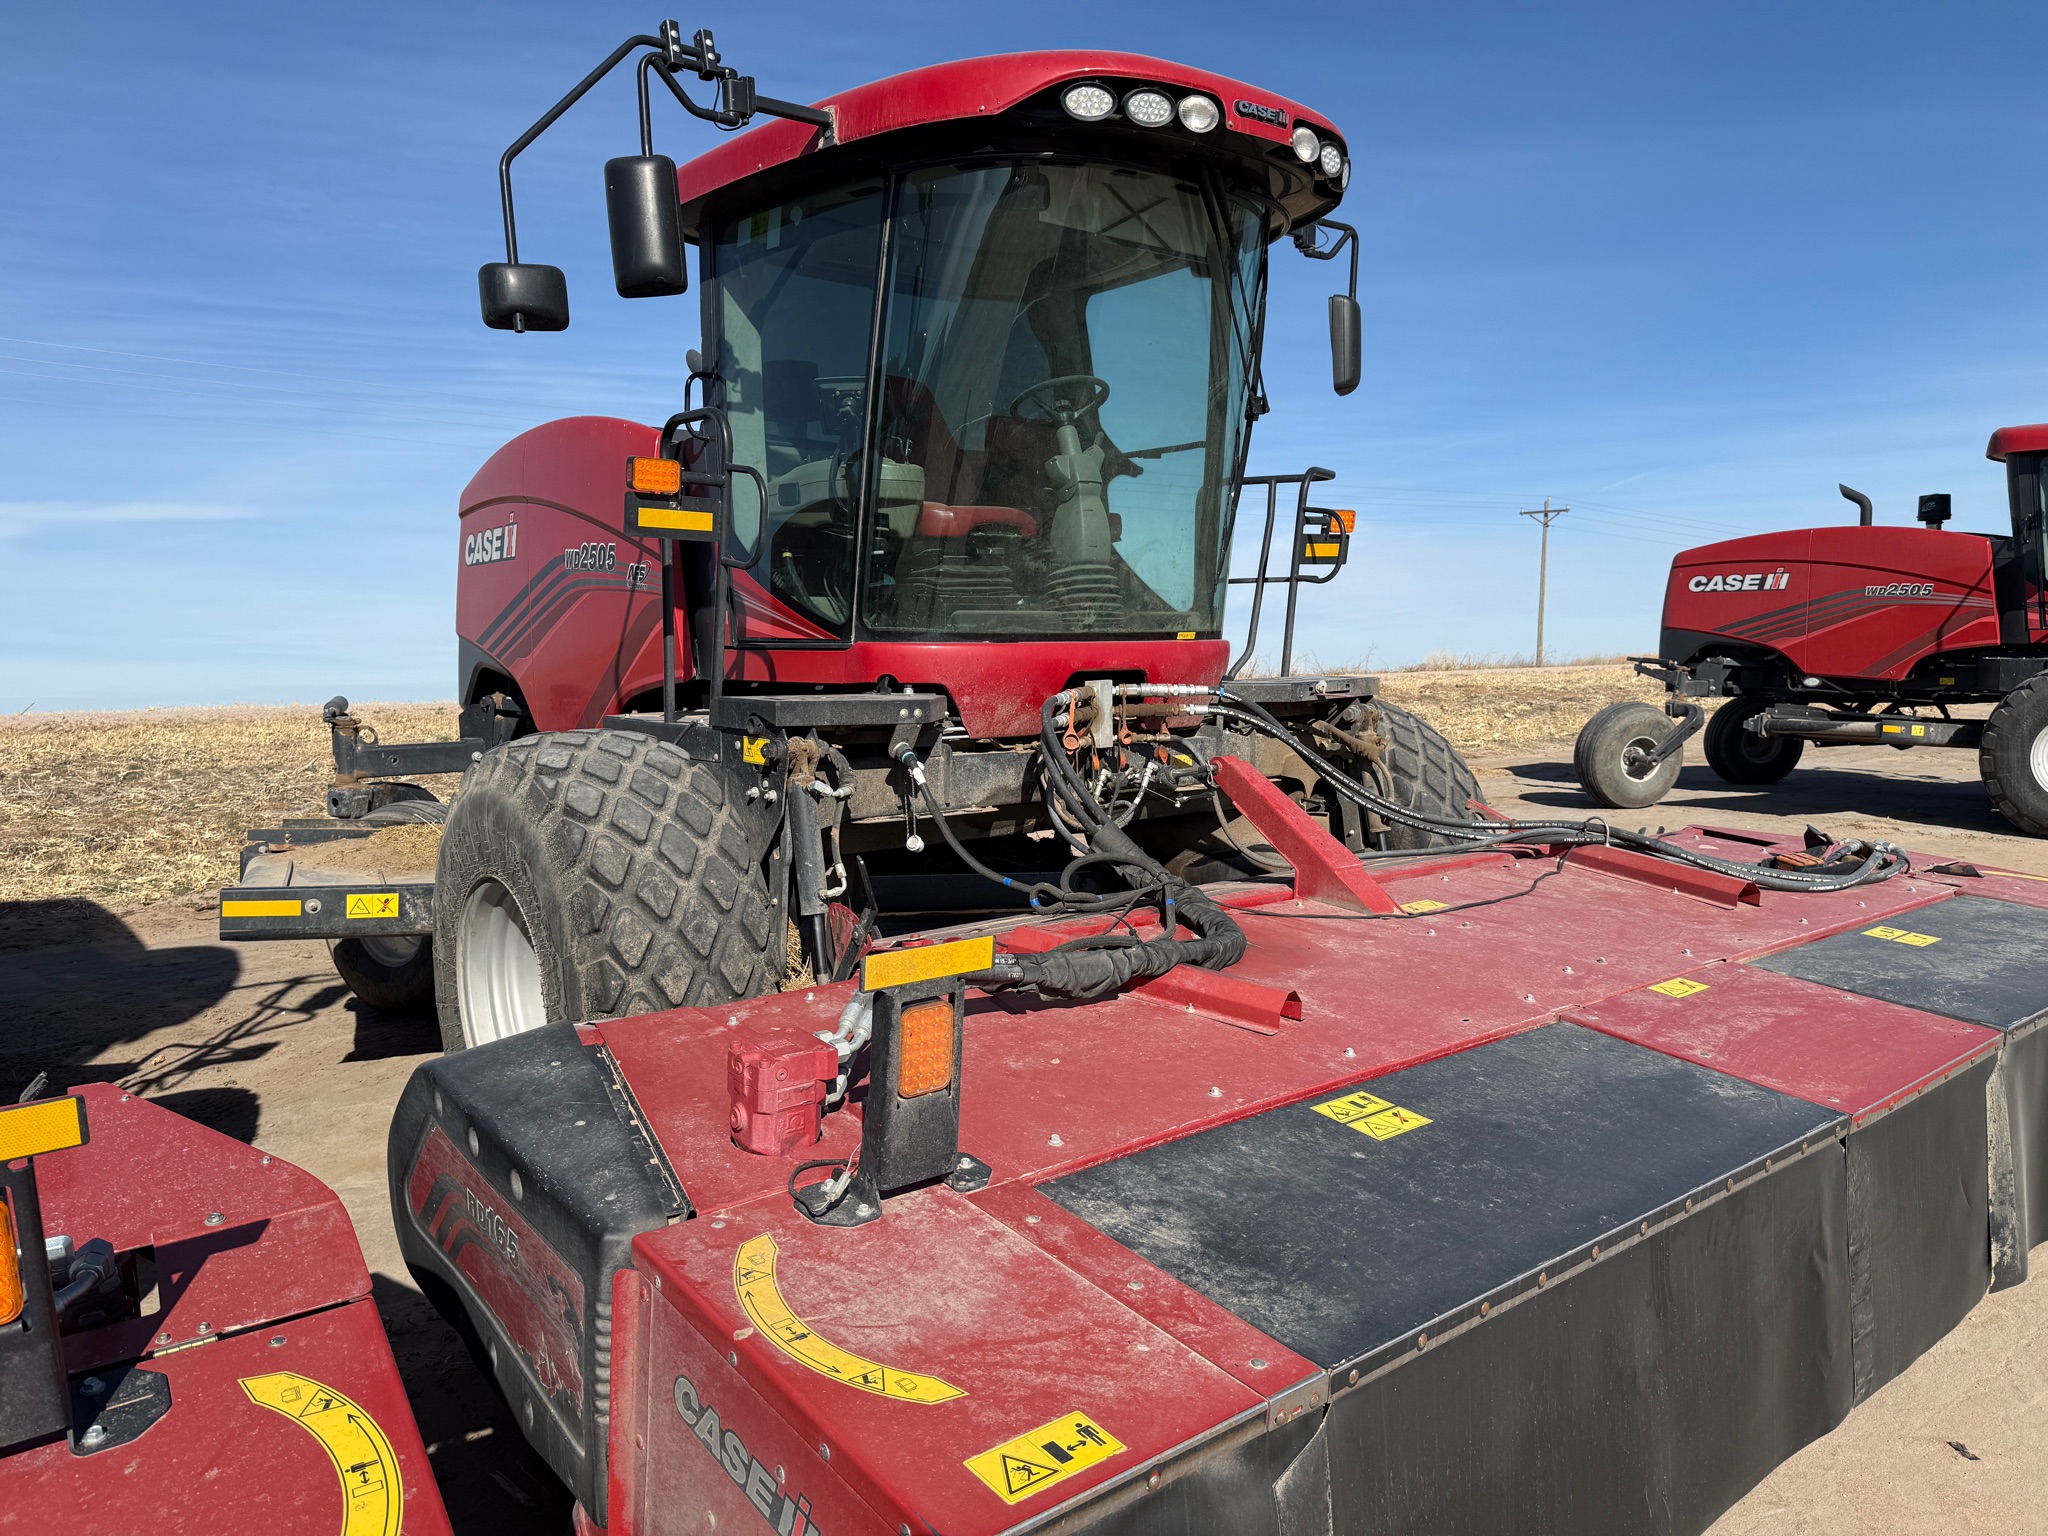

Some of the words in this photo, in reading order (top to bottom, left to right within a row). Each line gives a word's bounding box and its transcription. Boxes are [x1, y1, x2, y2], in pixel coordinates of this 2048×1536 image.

[1238, 100, 1276, 119] CASE
[465, 527, 503, 566] CASE
[564, 542, 616, 572] WD2505
[626, 562, 647, 583] AFS
[1688, 573, 1763, 593] CASE
[1865, 583, 1934, 598] WD2505
[674, 1375, 778, 1519] CASE
